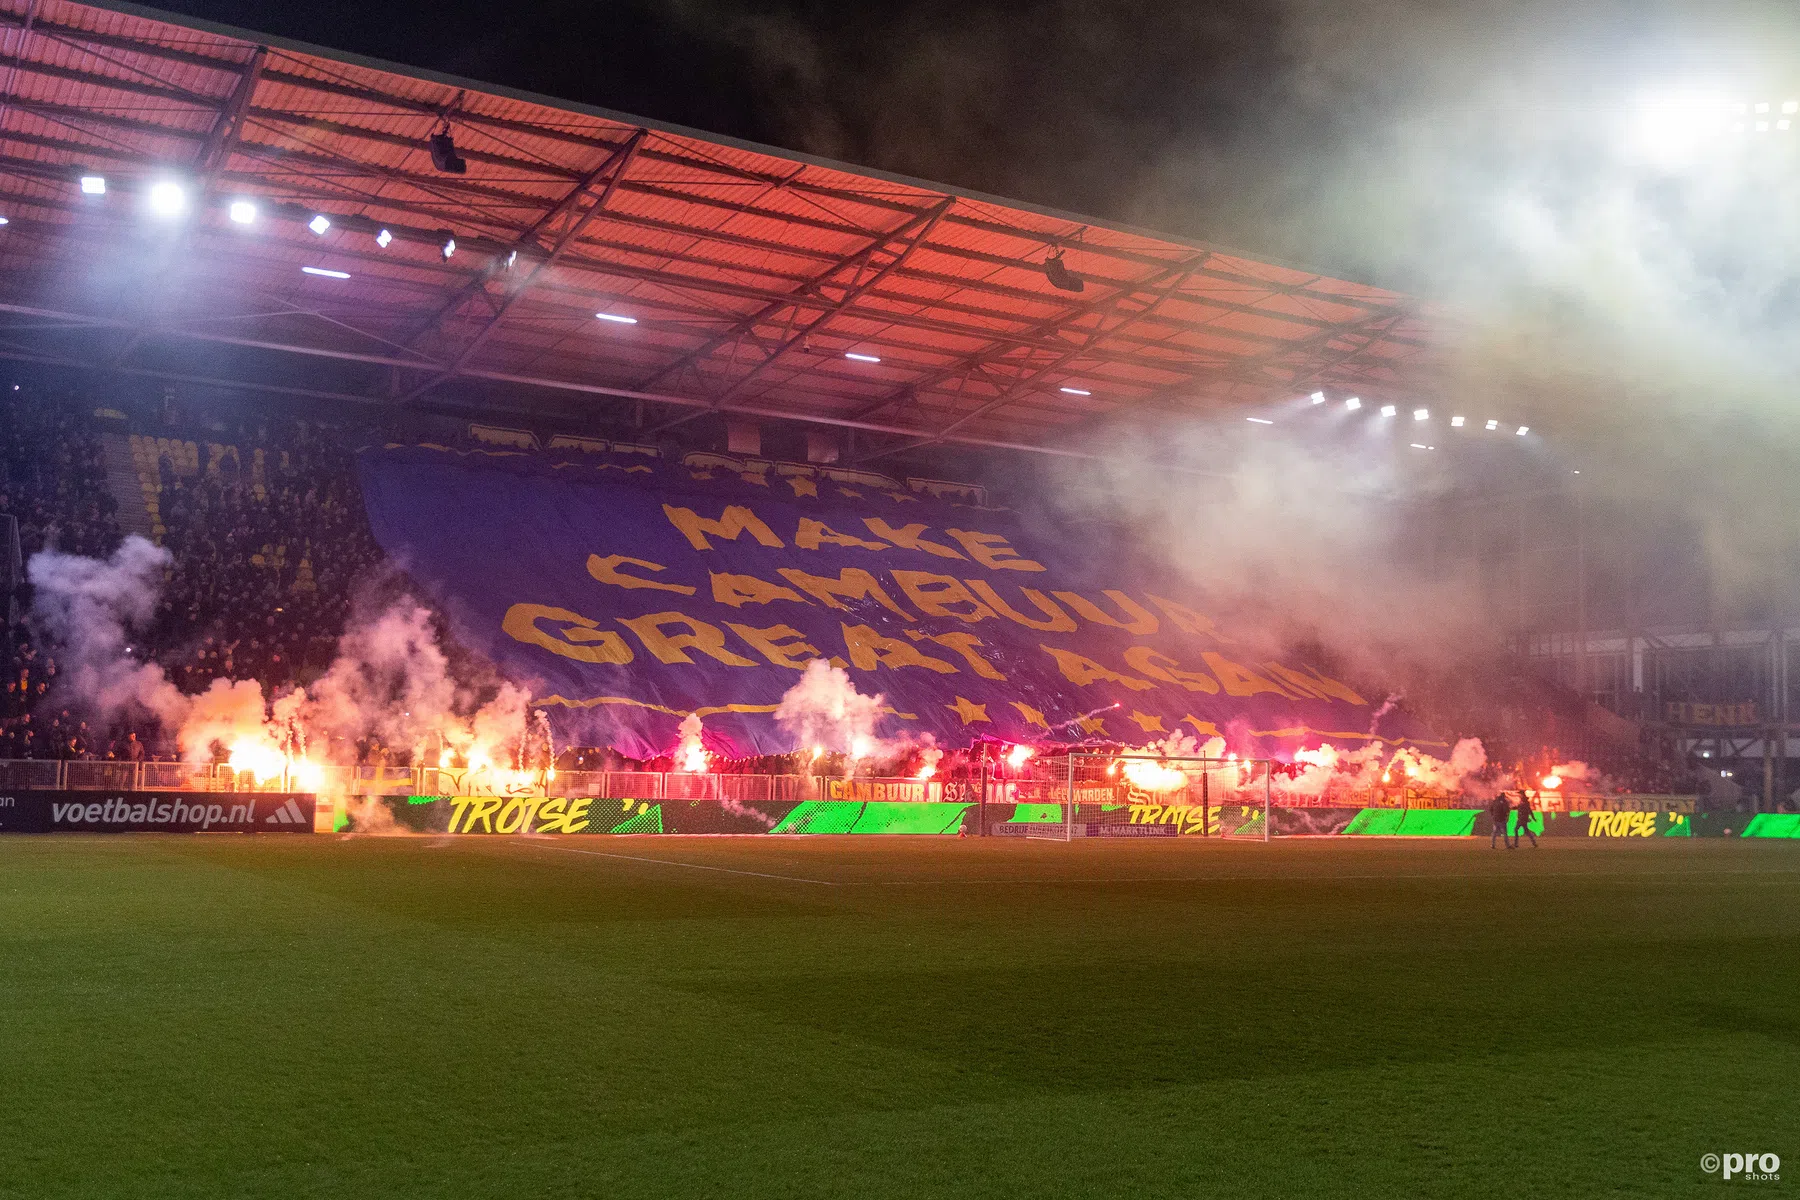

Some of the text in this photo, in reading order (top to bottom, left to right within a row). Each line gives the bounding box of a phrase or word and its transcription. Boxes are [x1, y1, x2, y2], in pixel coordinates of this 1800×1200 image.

[662, 504, 1047, 572] MAKE
[586, 553, 1238, 646] CAMBUUR
[501, 602, 1369, 706] GREAT AGAIN
[52, 798, 255, 829] voetbalshop.nl
[830, 780, 925, 802] CAMBUUR
[1000, 825, 1028, 834] BEDRIJF
